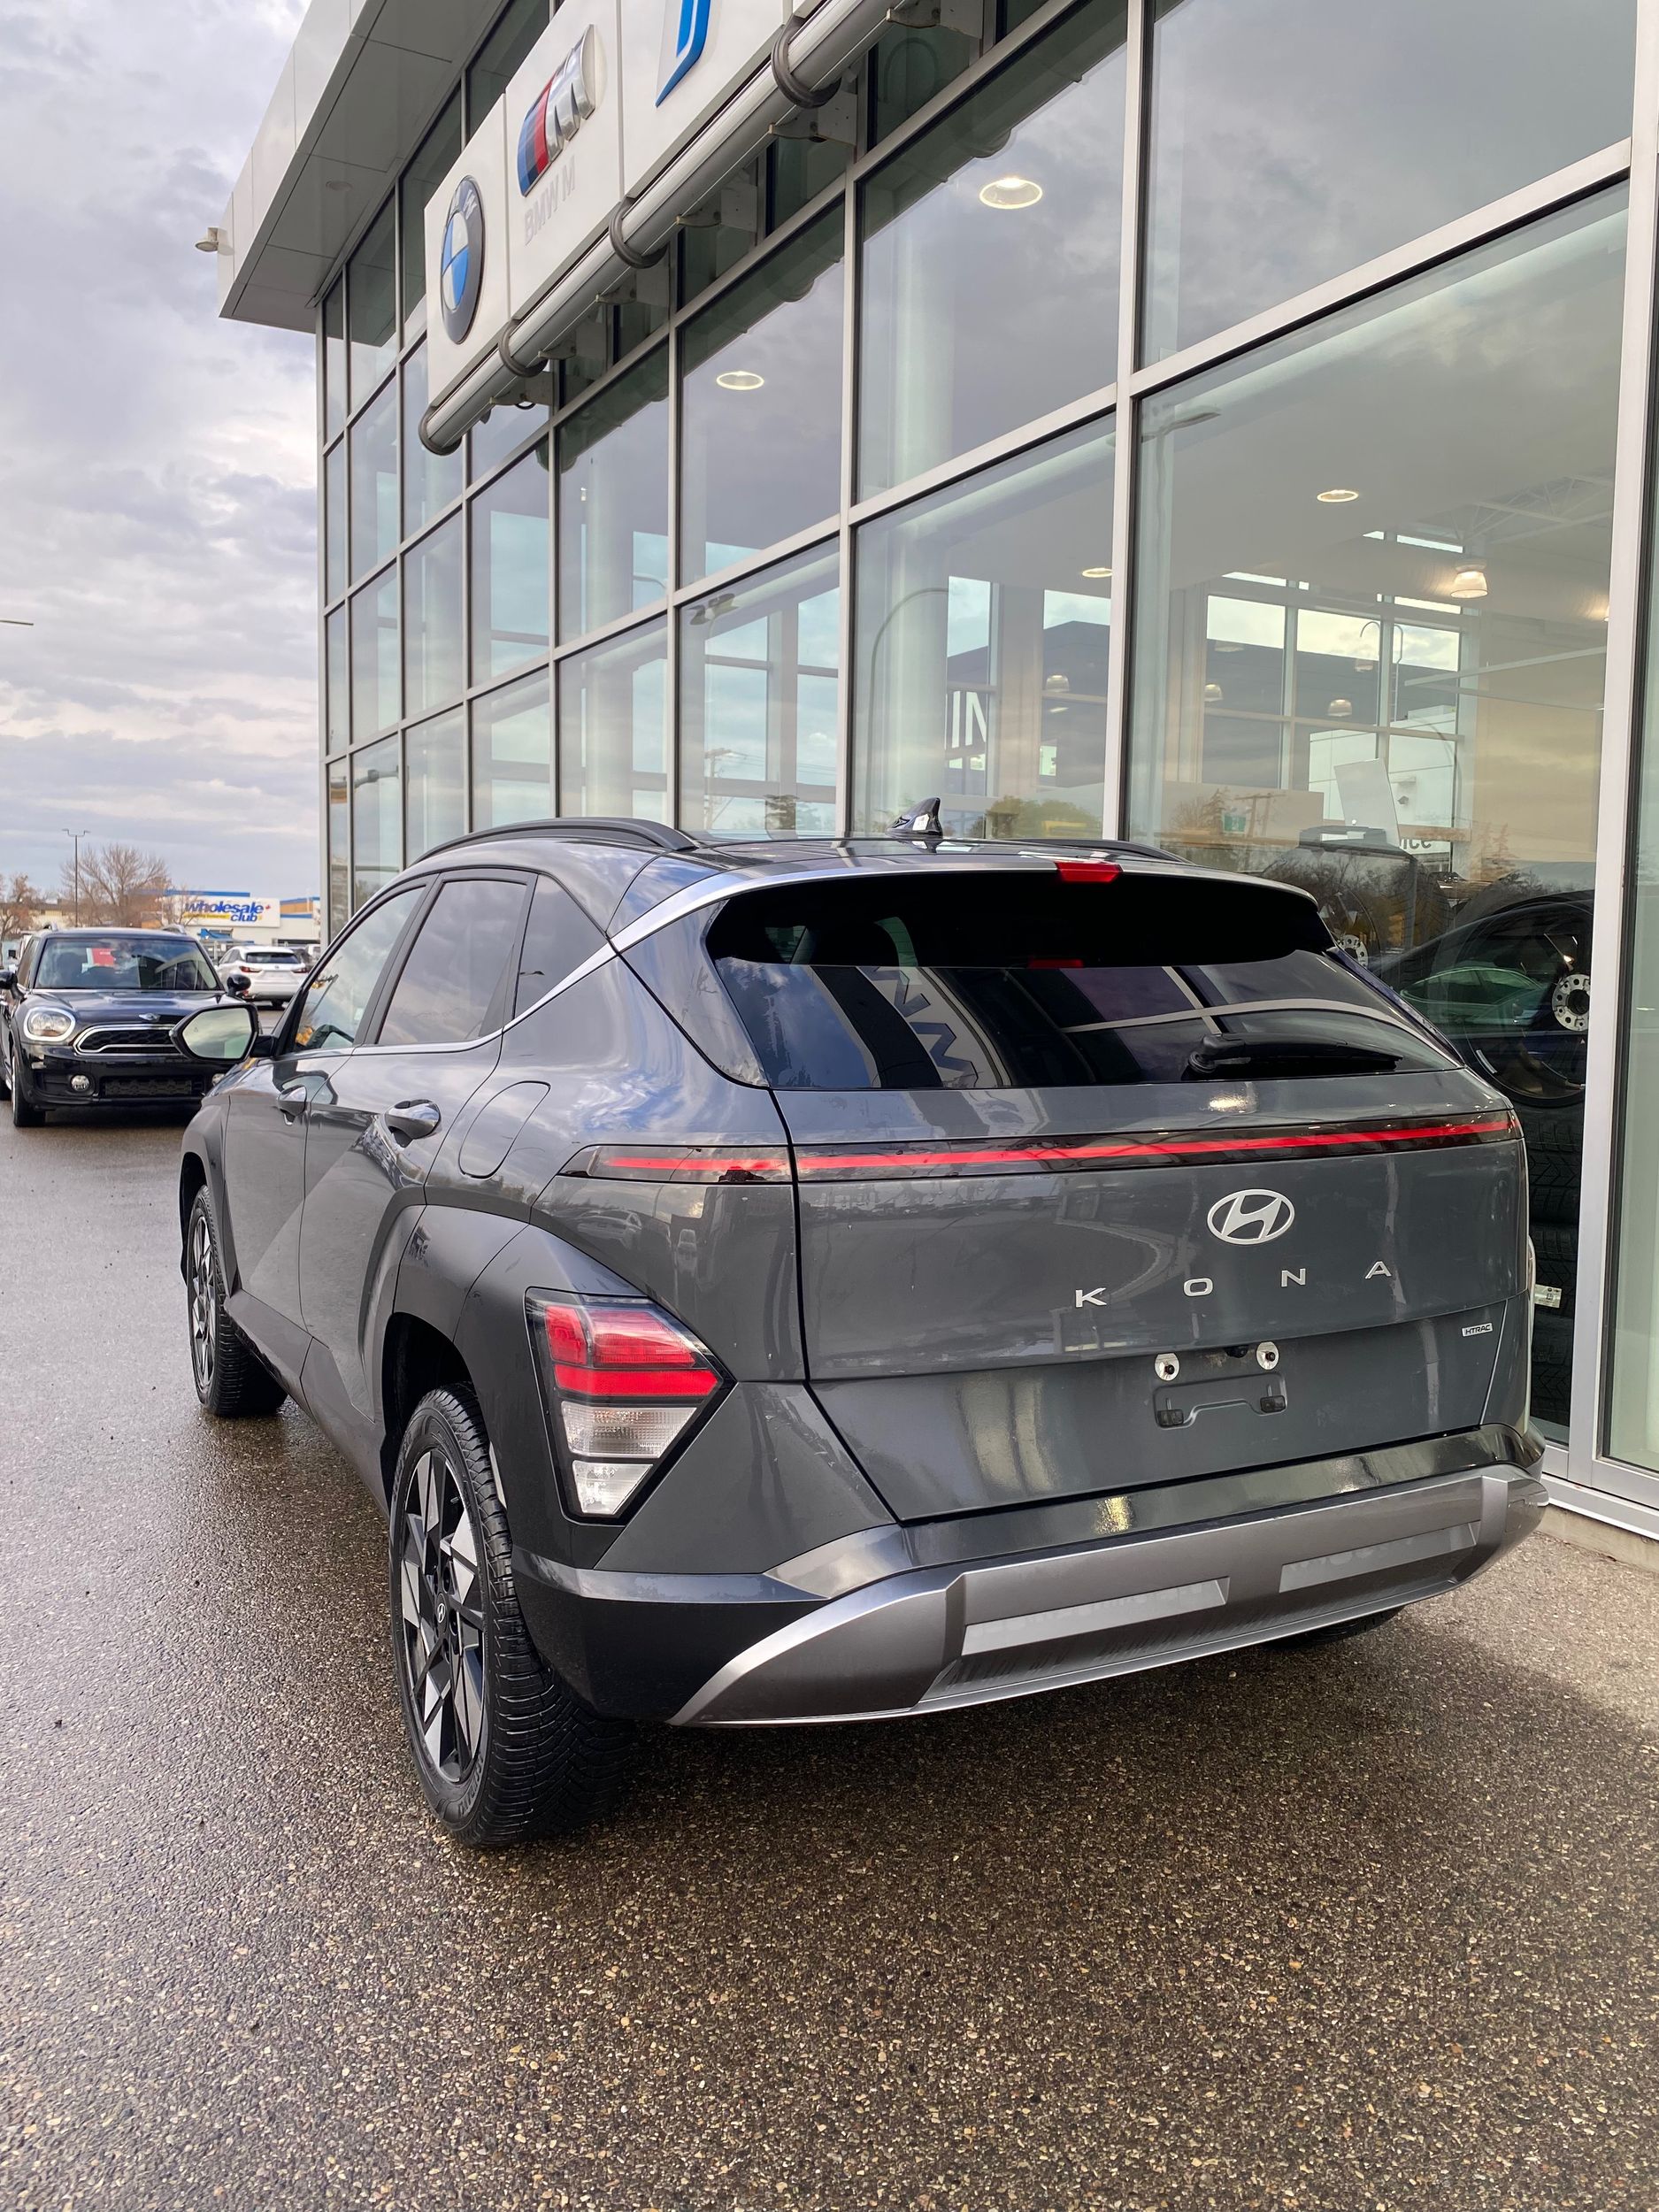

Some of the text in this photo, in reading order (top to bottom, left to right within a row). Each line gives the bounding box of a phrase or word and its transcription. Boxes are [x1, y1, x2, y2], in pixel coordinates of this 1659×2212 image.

[525, 154, 575, 246] BMW M
[184, 901, 265, 914] wholesale
[230, 912, 257, 922] club
[1075, 1261, 1392, 1308] KONA
[1464, 1324, 1491, 1335] HTRAC
